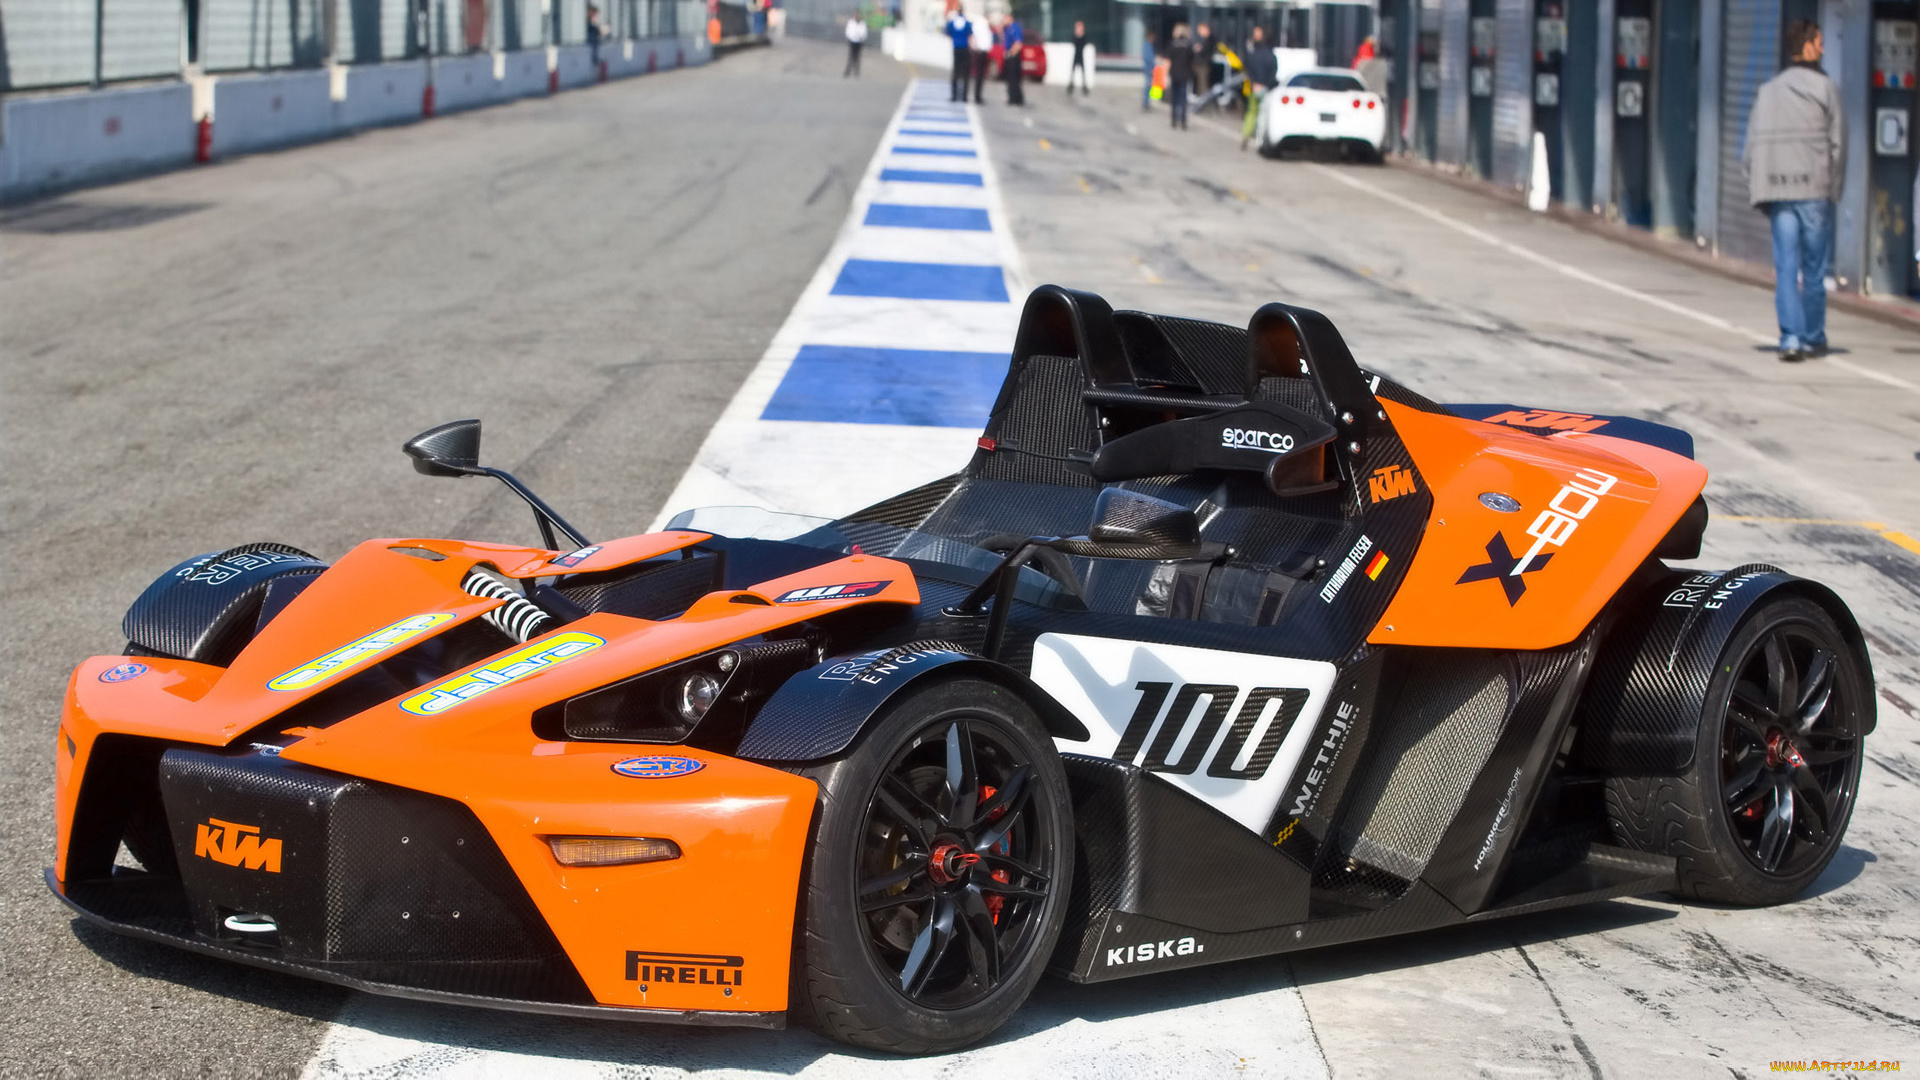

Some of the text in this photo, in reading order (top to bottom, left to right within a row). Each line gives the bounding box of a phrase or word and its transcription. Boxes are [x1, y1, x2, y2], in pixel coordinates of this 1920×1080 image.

[1222, 427, 1295, 453] sparco
[1481, 409, 1610, 433] KTM
[1368, 464, 1417, 503] KTM
[1319, 533, 1374, 604] CATHARINA FELSER
[420, 641, 598, 713] dallara
[1111, 681, 1311, 781] 100
[1288, 700, 1354, 816] WETHJE
[195, 817, 283, 873] KTM
[625, 950, 744, 986] PIRELLI
